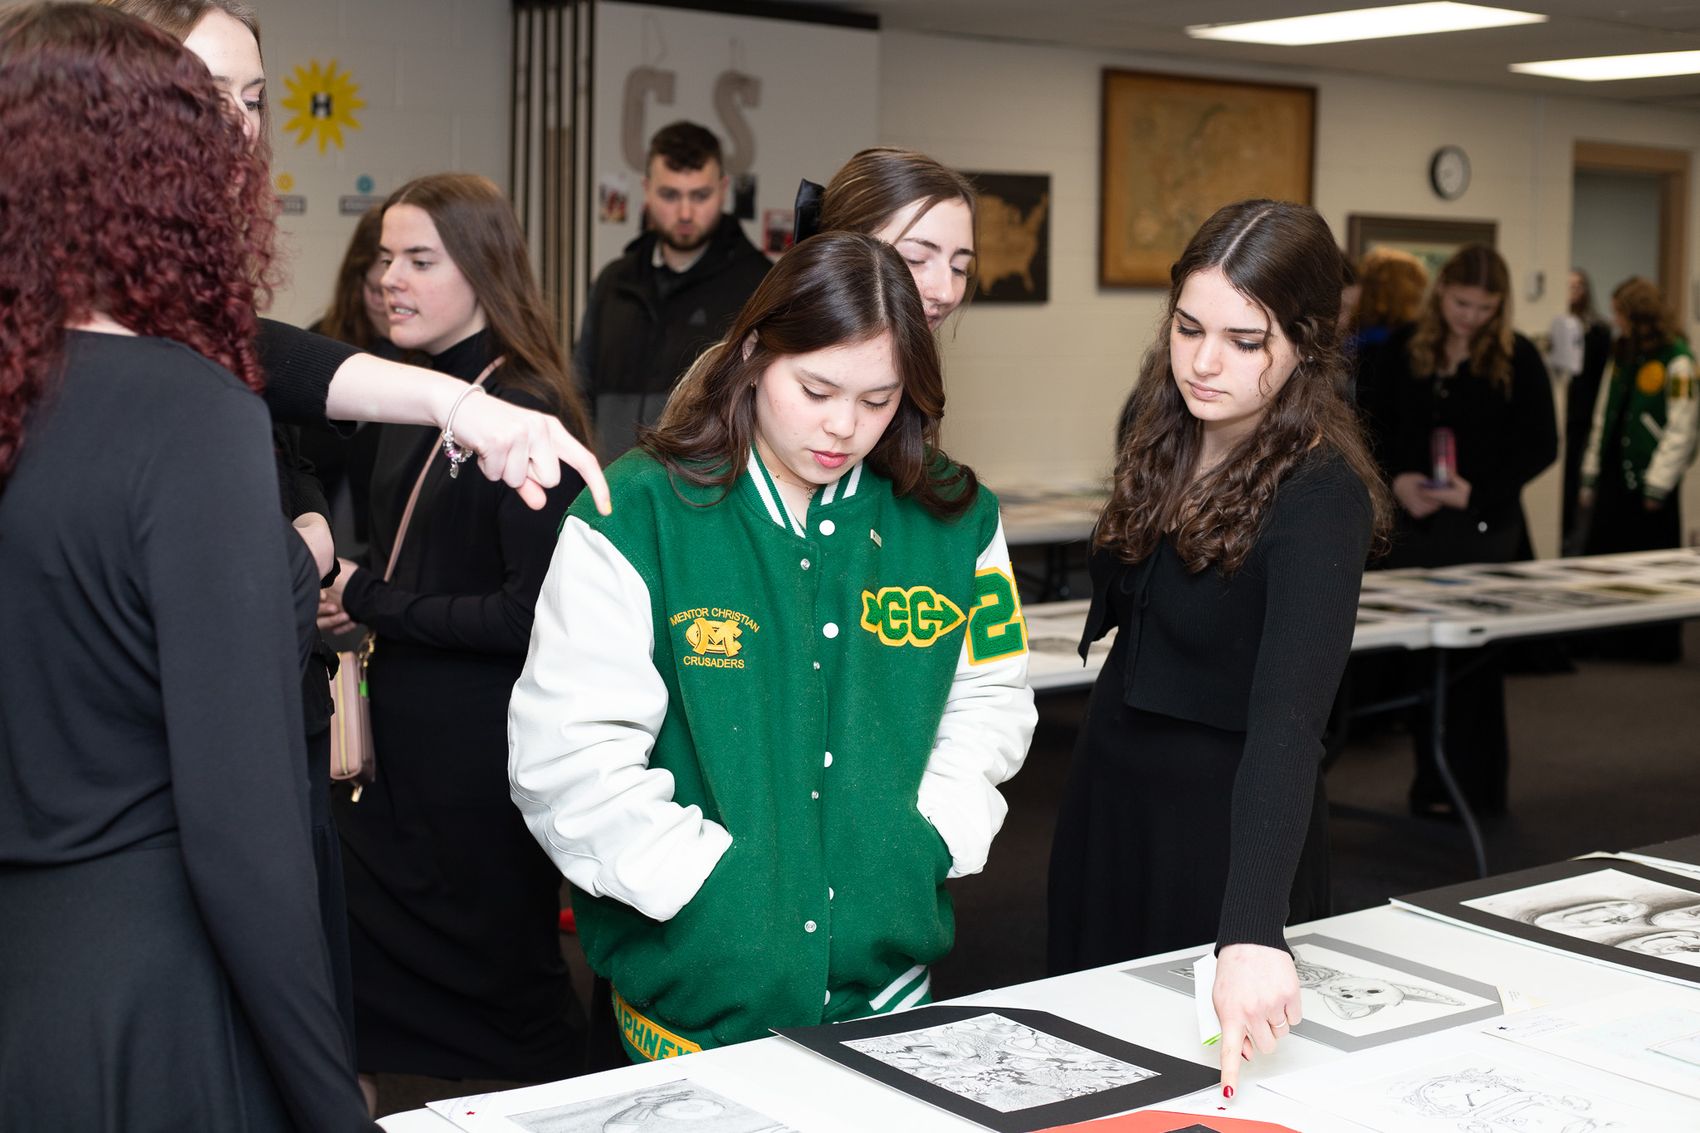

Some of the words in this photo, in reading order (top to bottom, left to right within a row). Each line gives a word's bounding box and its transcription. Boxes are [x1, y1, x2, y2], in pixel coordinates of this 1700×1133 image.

[310, 89, 333, 118] H
[669, 607, 710, 627] MENTOR
[711, 607, 760, 633] CHRISTIAN
[966, 568, 1026, 664] 2
[683, 655, 745, 669] CRUSADERS
